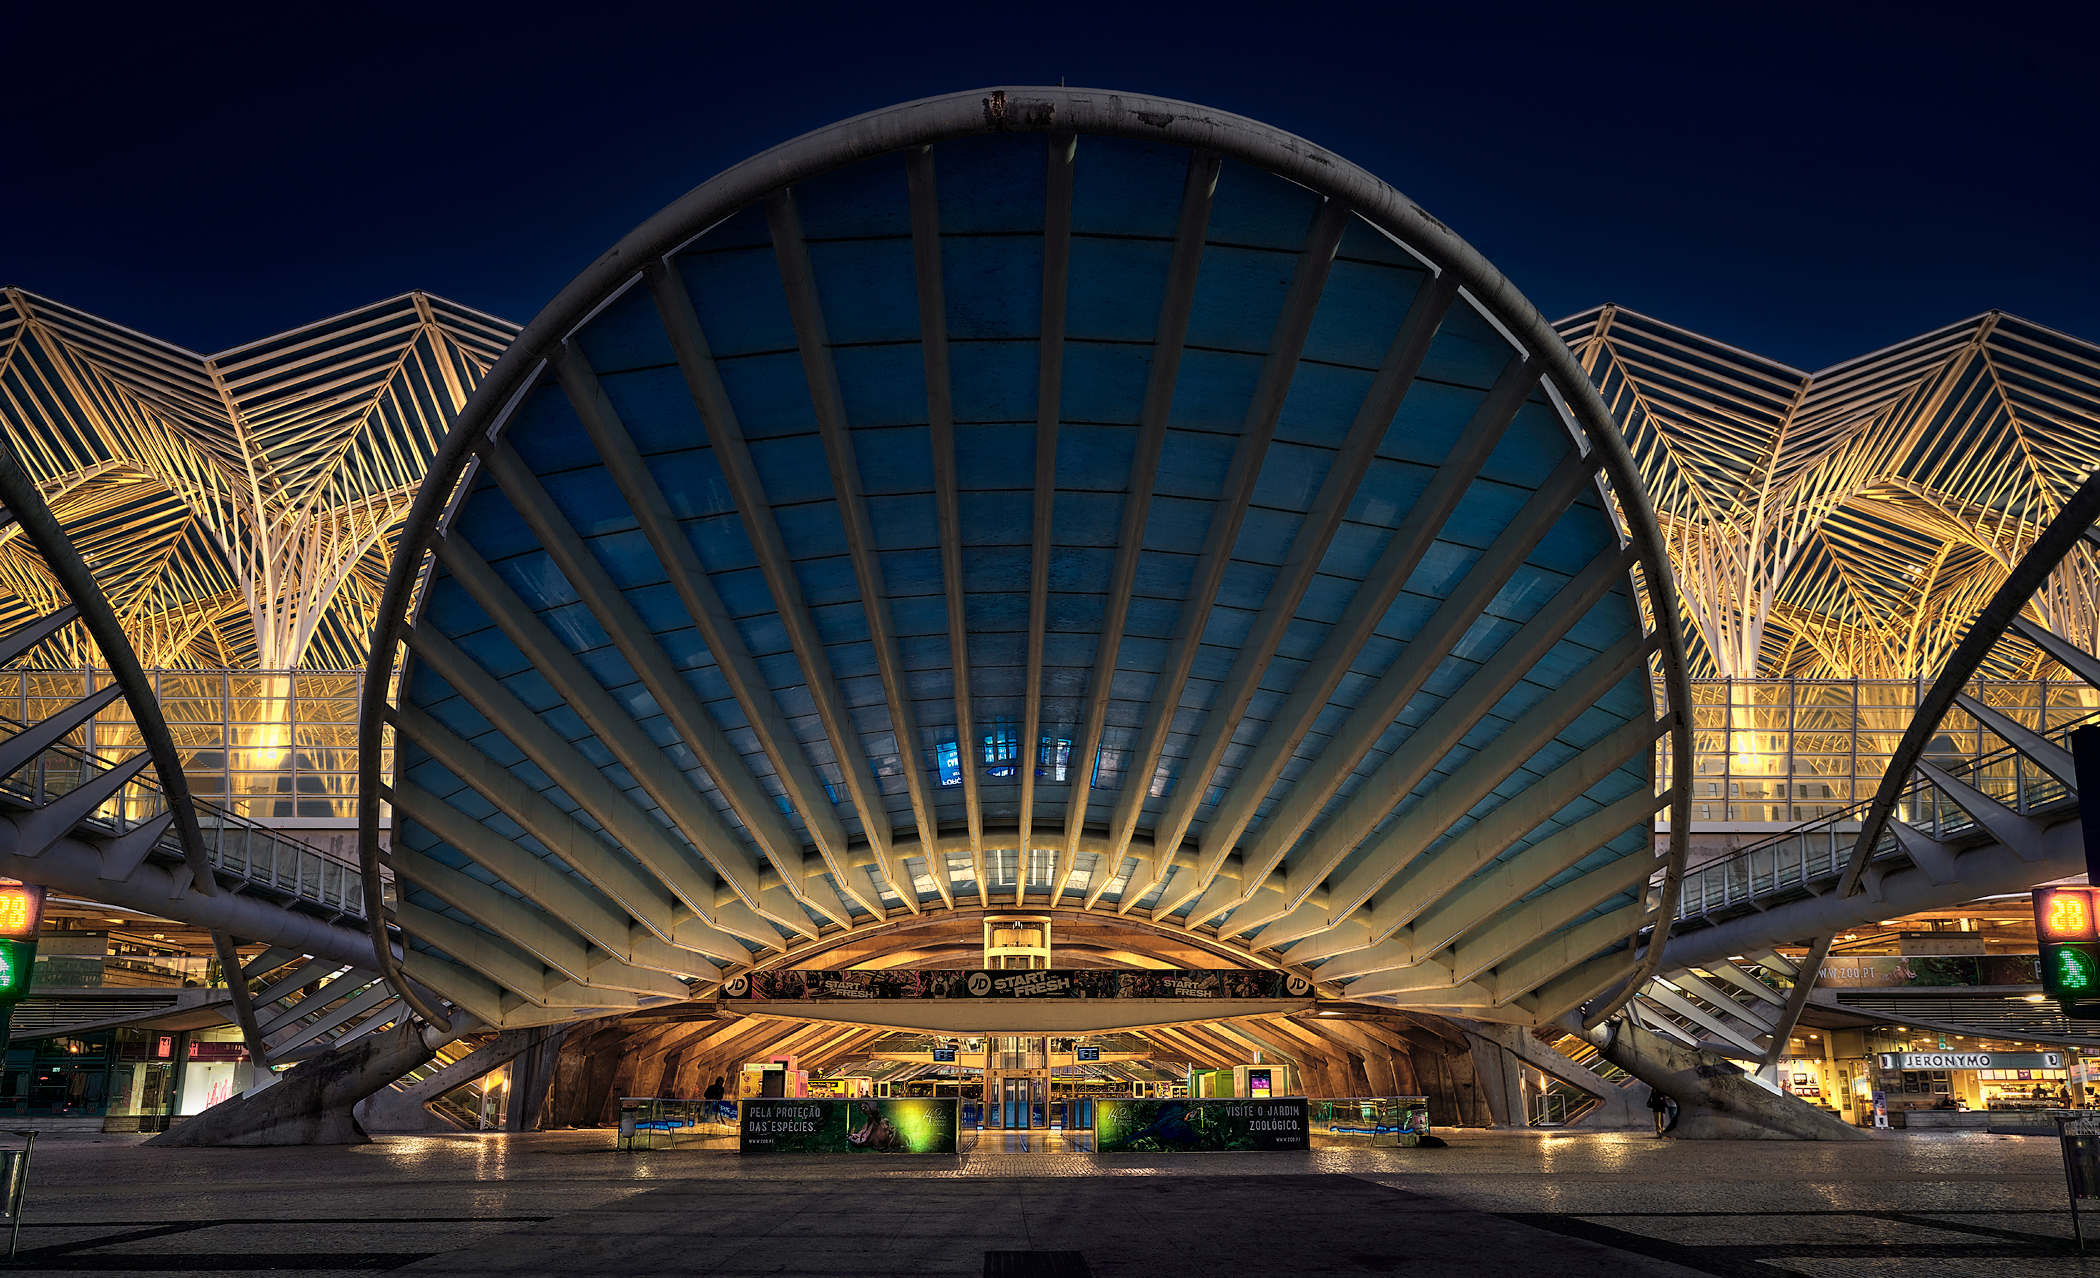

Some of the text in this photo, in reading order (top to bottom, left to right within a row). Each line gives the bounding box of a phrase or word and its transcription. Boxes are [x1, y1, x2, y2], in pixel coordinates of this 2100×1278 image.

[2050, 900, 2084, 930] 28
[824, 980, 861, 990] START
[970, 977, 989, 990] JD
[993, 971, 1048, 990] START
[1163, 979, 1199, 989] START
[835, 988, 874, 999] FRESH
[1013, 977, 1070, 998] FRESH
[1174, 988, 1212, 998] FRESH
[1906, 1055, 1990, 1067] JERONYMO
[749, 1107, 772, 1118] PELA
[776, 1105, 821, 1119] PROTEÇÃO
[1225, 1105, 1300, 1117] VISITE O JARDIM
[749, 1119, 817, 1132] DAS ESPÉCIES.
[1249, 1117, 1301, 1131] ZOOLÓGICO.
